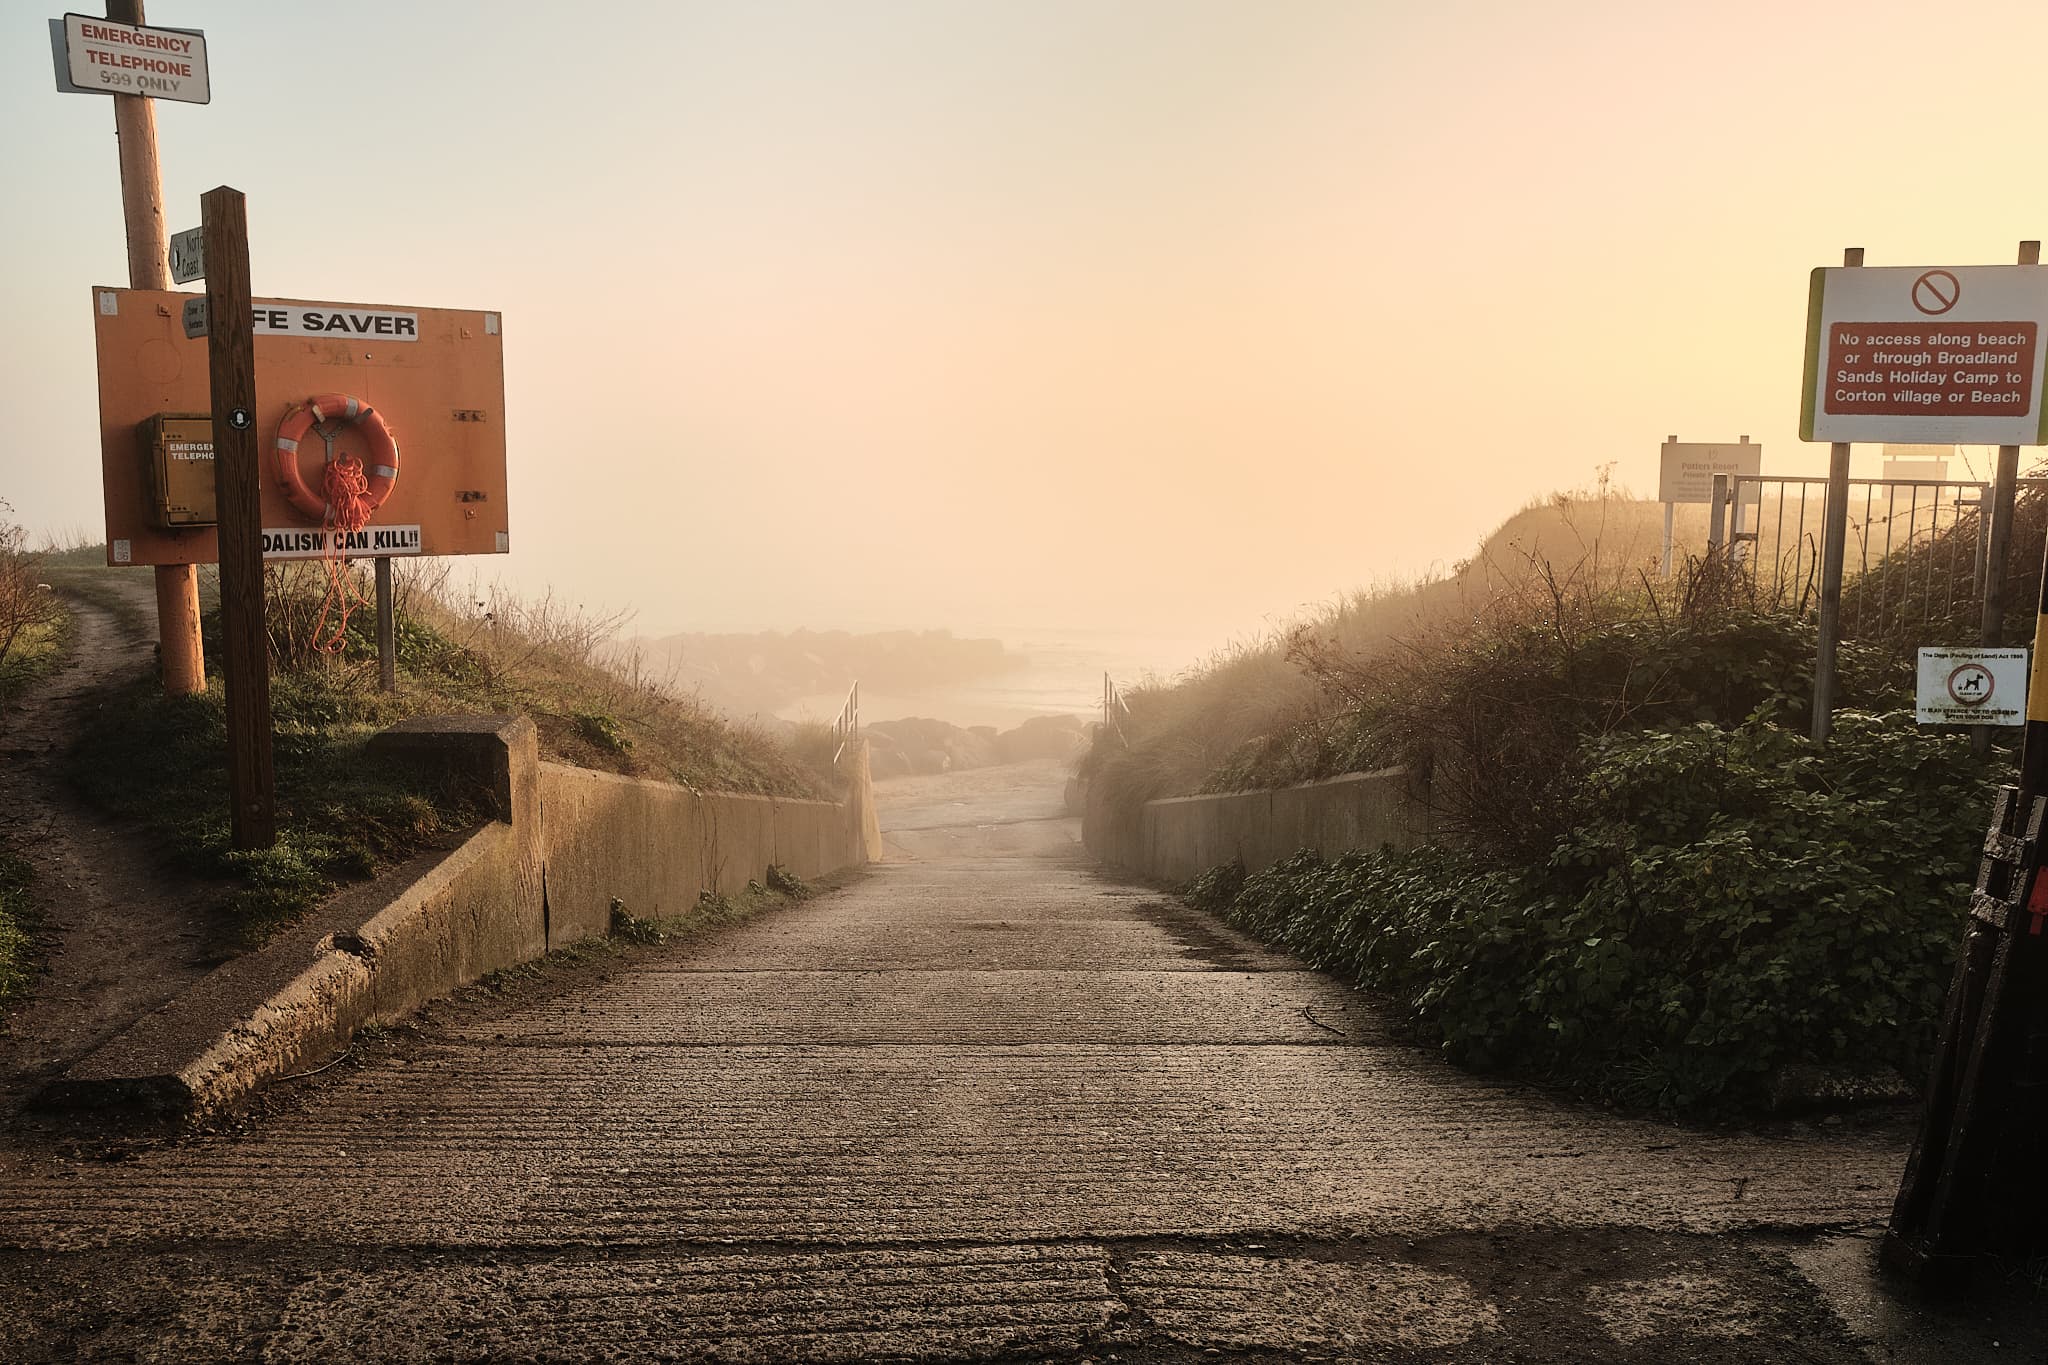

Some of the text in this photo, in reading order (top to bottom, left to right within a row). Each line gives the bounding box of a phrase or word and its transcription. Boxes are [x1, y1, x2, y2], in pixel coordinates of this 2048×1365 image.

[81, 23, 191, 53] EMERGENCY
[86, 49, 192, 77] TELEPHONE
[100, 70, 180, 92] 999 ONLY
[182, 258, 199, 277] Coast
[302, 312, 415, 335] SAVER
[1839, 333, 2026, 347] No access along beach
[1845, 352, 2018, 366] or through Broadland
[1836, 370, 2022, 385] Sands Holiday Camp to
[1835, 390, 2020, 405] Corton village or Beach
[1713, 462, 1738, 471] Resort
[334, 531, 369, 550] CAN
[375, 530, 418, 548] KILL!!
